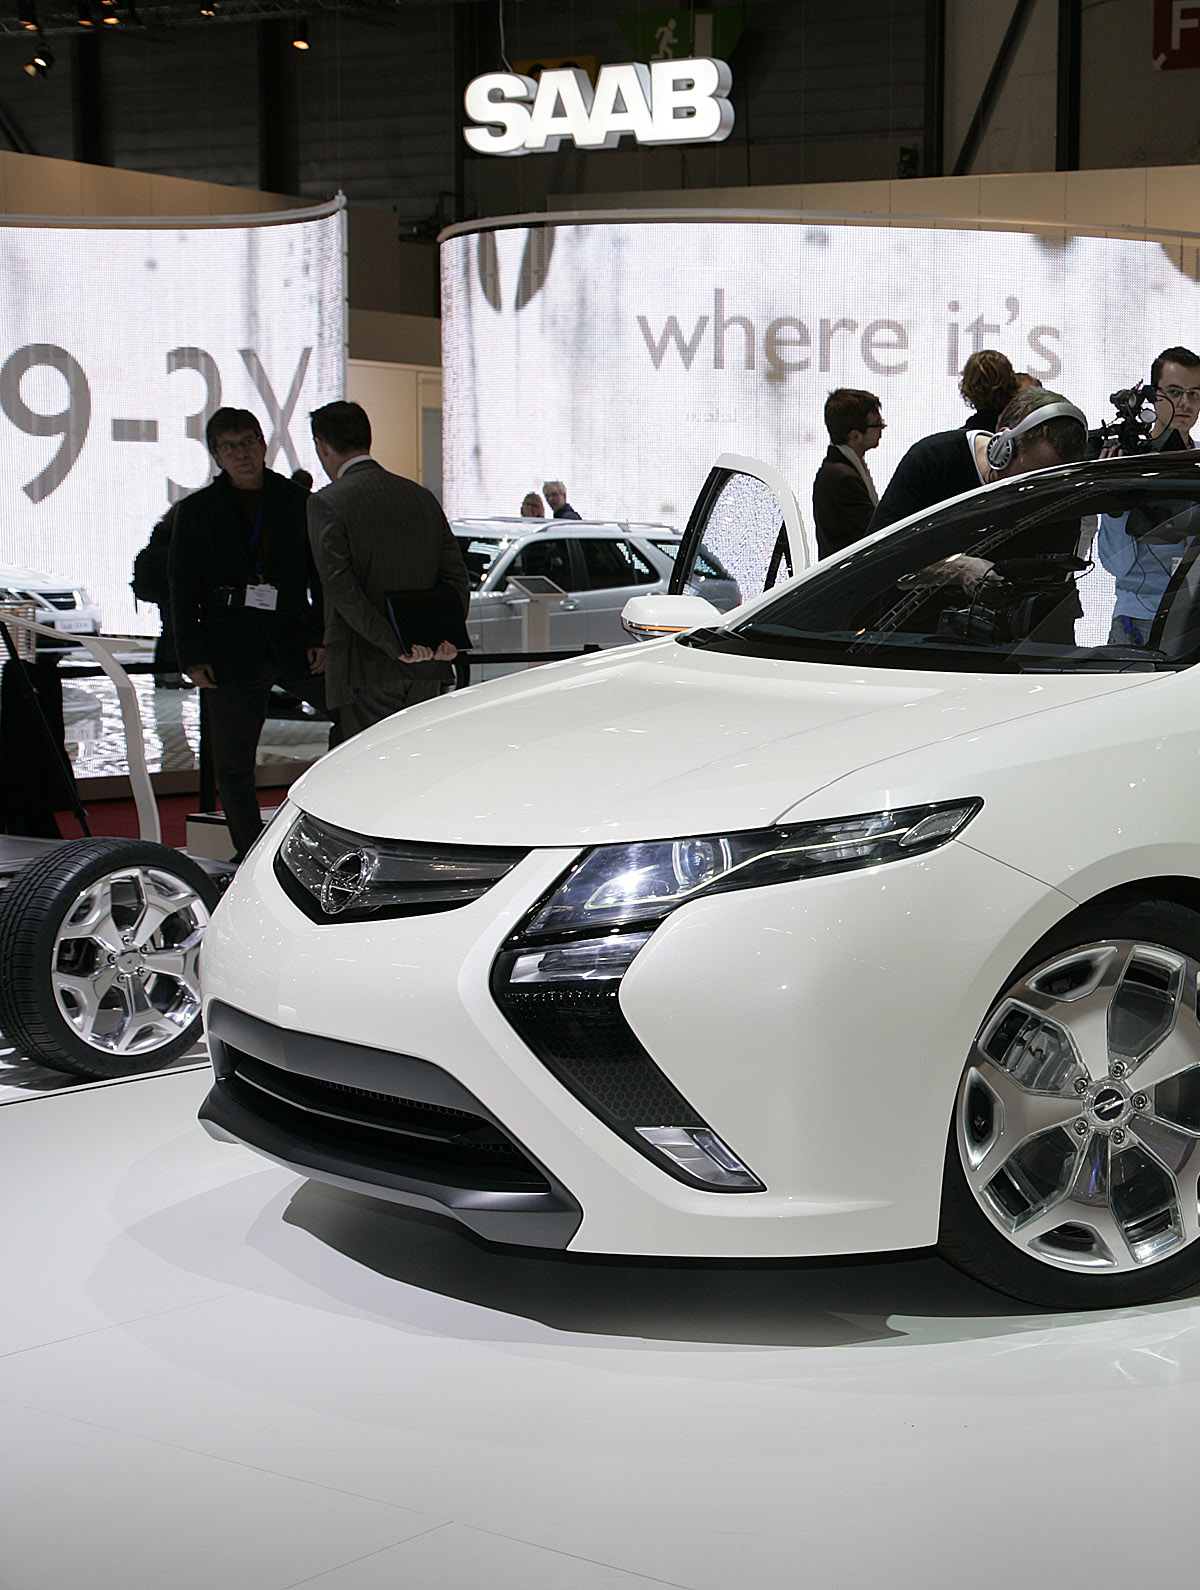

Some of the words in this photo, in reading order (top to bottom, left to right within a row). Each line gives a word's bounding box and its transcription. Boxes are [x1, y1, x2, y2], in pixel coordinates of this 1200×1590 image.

[463, 57, 735, 157] SAAB
[636, 288, 909, 376] where
[947, 294, 1062, 381] it's
[0, 343, 313, 504] 9-3X
